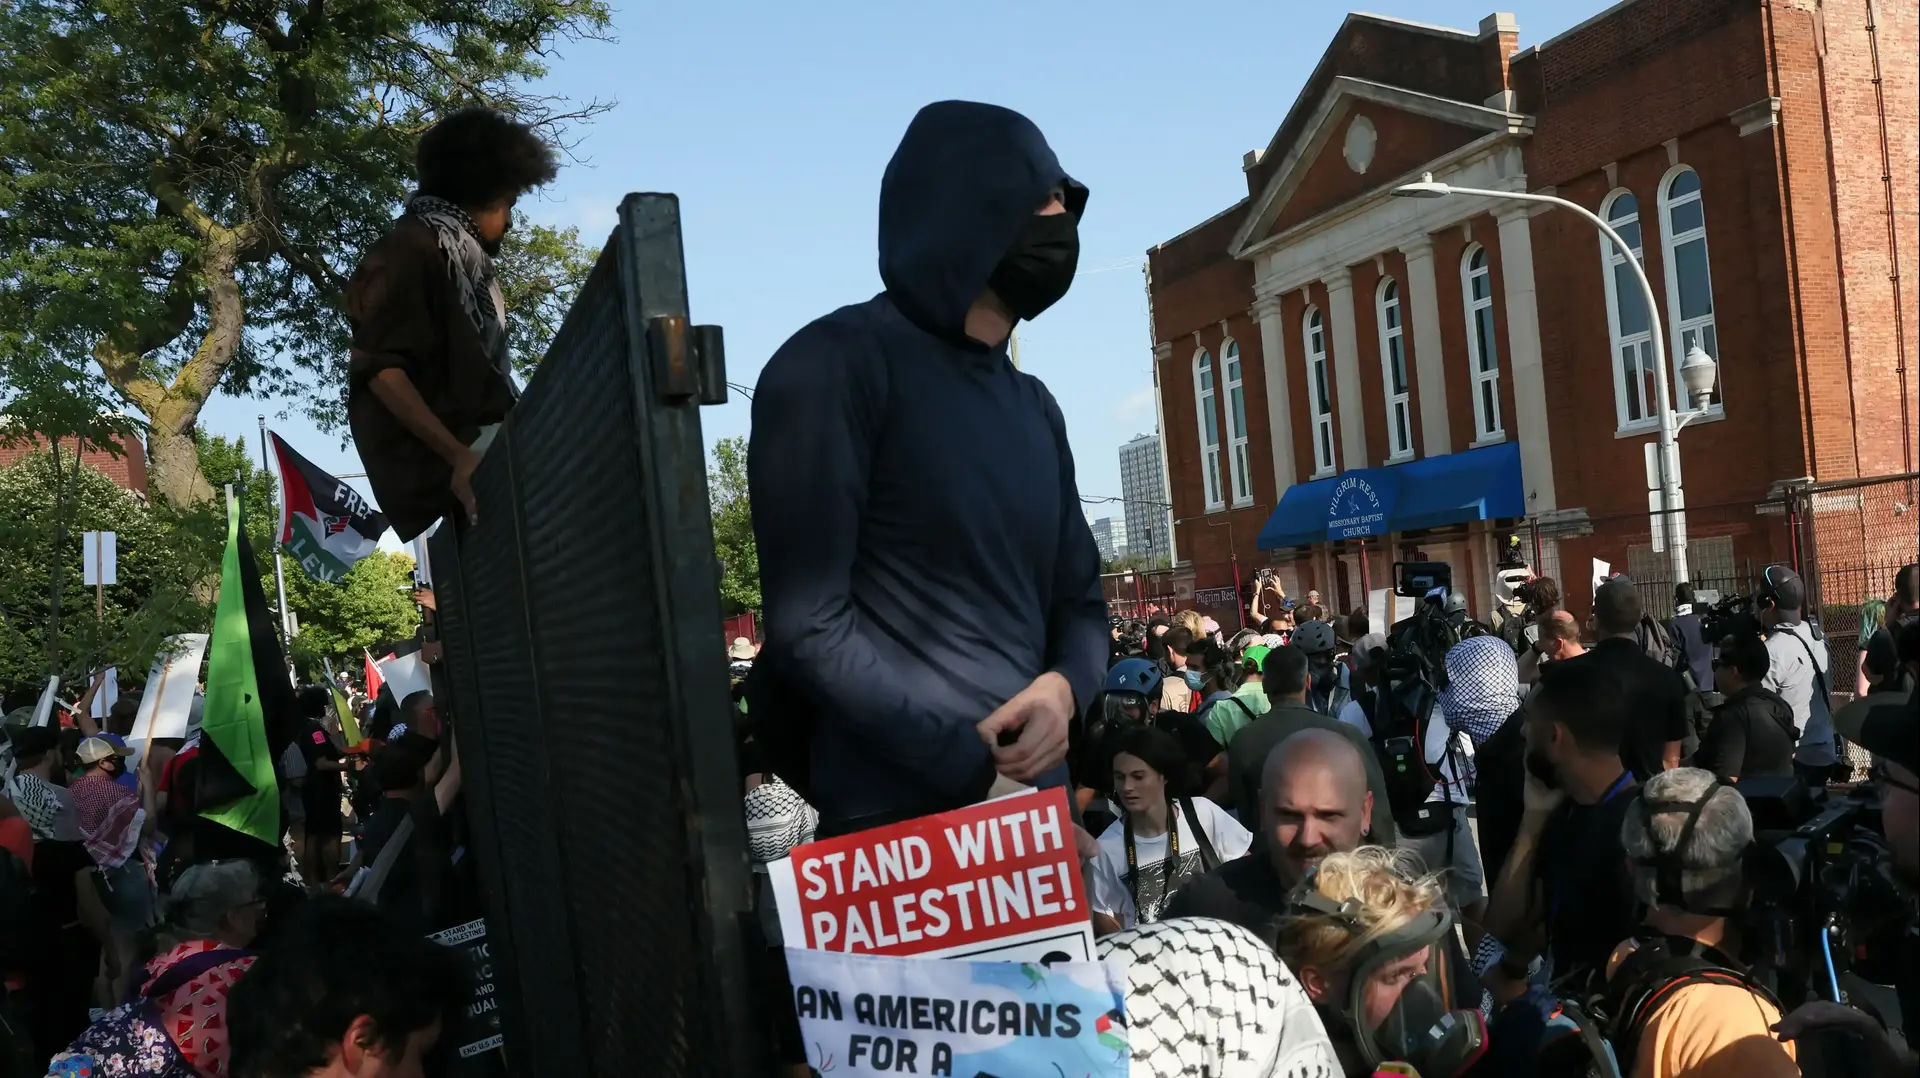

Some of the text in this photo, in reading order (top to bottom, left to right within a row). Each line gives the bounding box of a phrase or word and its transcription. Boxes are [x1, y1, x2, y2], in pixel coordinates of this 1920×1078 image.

[1329, 477, 1380, 516] PILGRIM REST
[1328, 513, 1383, 528] MISSIONARY BAPTIST
[1342, 525, 1371, 537] CHURCH
[1195, 591, 1221, 605] Pilgrim
[1221, 590, 1237, 601] Rest
[801, 805, 1064, 901] STAND WITH
[811, 861, 1077, 953] PALESTINE!
[443, 920, 485, 938] STAND WITH
[853, 993, 1081, 1038] AMERICANS
[462, 1045, 477, 1056] END
[491, 1036, 504, 1046] AID
[848, 1034, 952, 1077] FOR A
